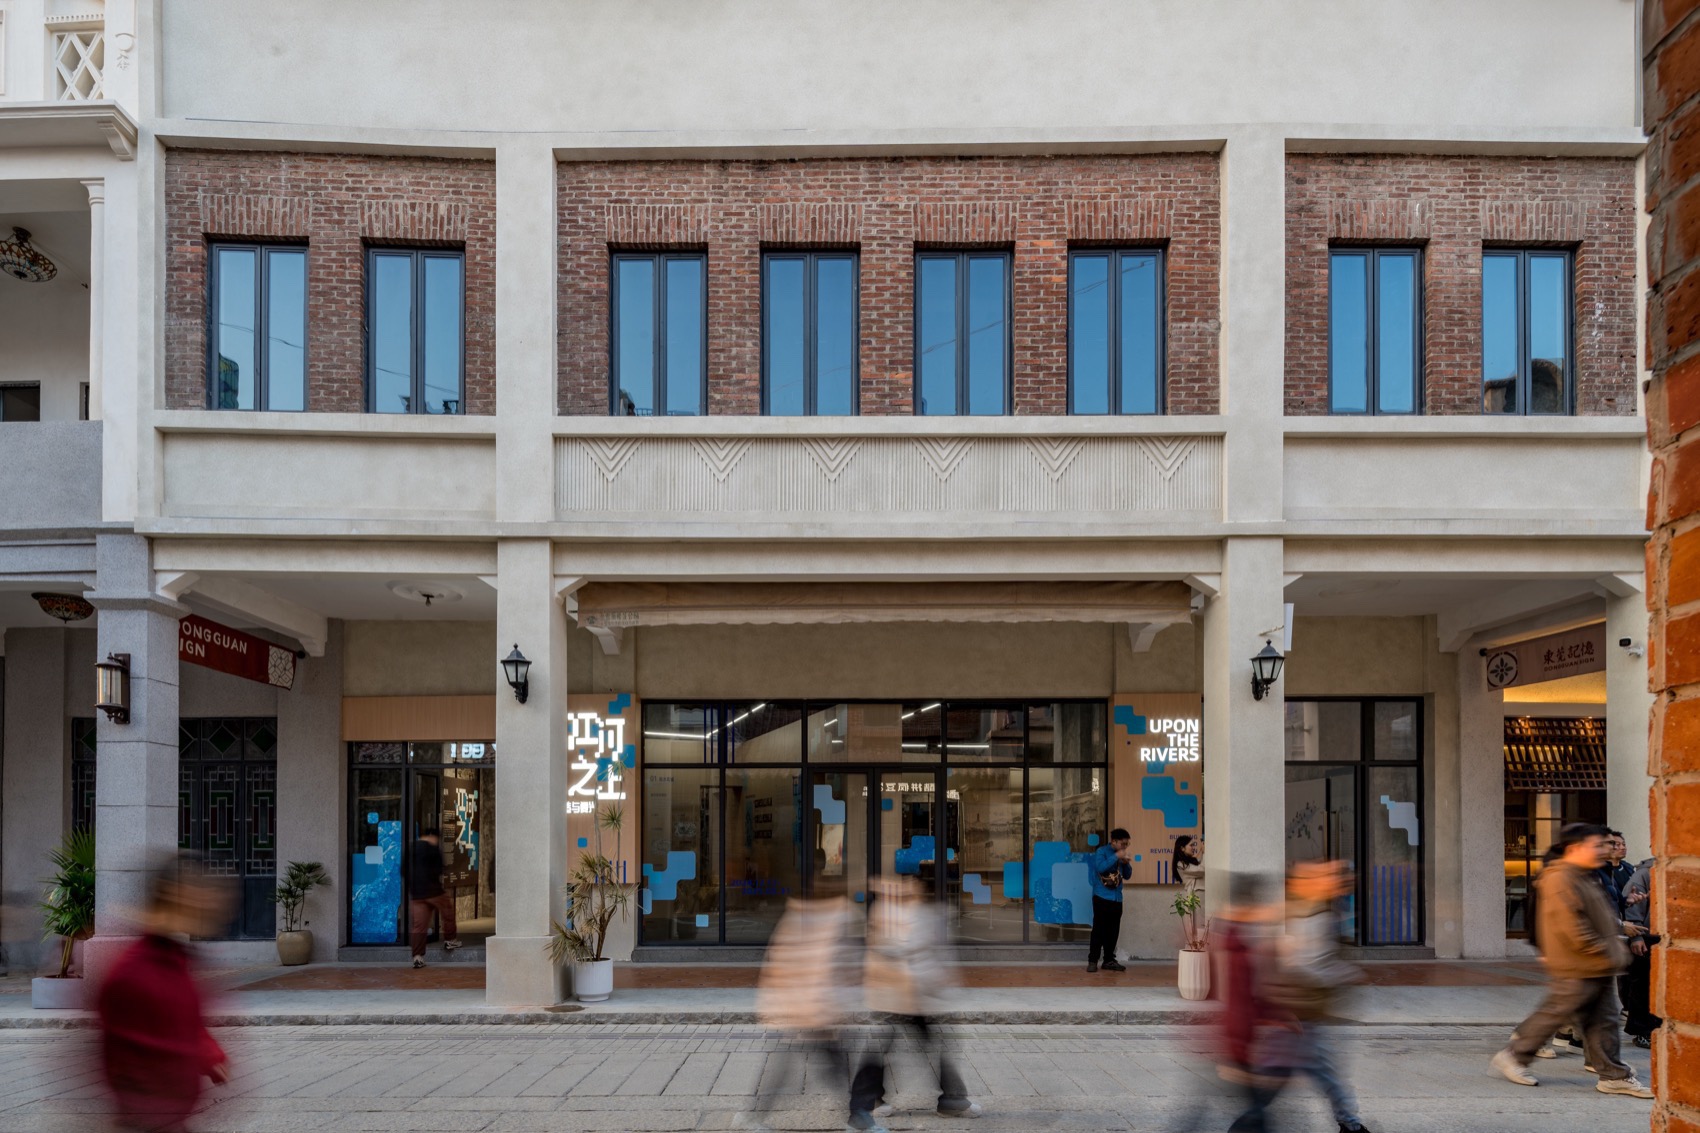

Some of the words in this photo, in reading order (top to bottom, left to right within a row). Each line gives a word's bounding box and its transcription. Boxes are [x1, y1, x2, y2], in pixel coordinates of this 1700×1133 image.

[179, 621, 247, 655] ONGGUAN
[180, 638, 205, 658] IGN
[1150, 719, 1199, 733] UPON
[567, 712, 626, 762] 江河
[1166, 733, 1199, 747] THE
[1140, 747, 1199, 762] RIVERS
[567, 754, 627, 800] 之上
